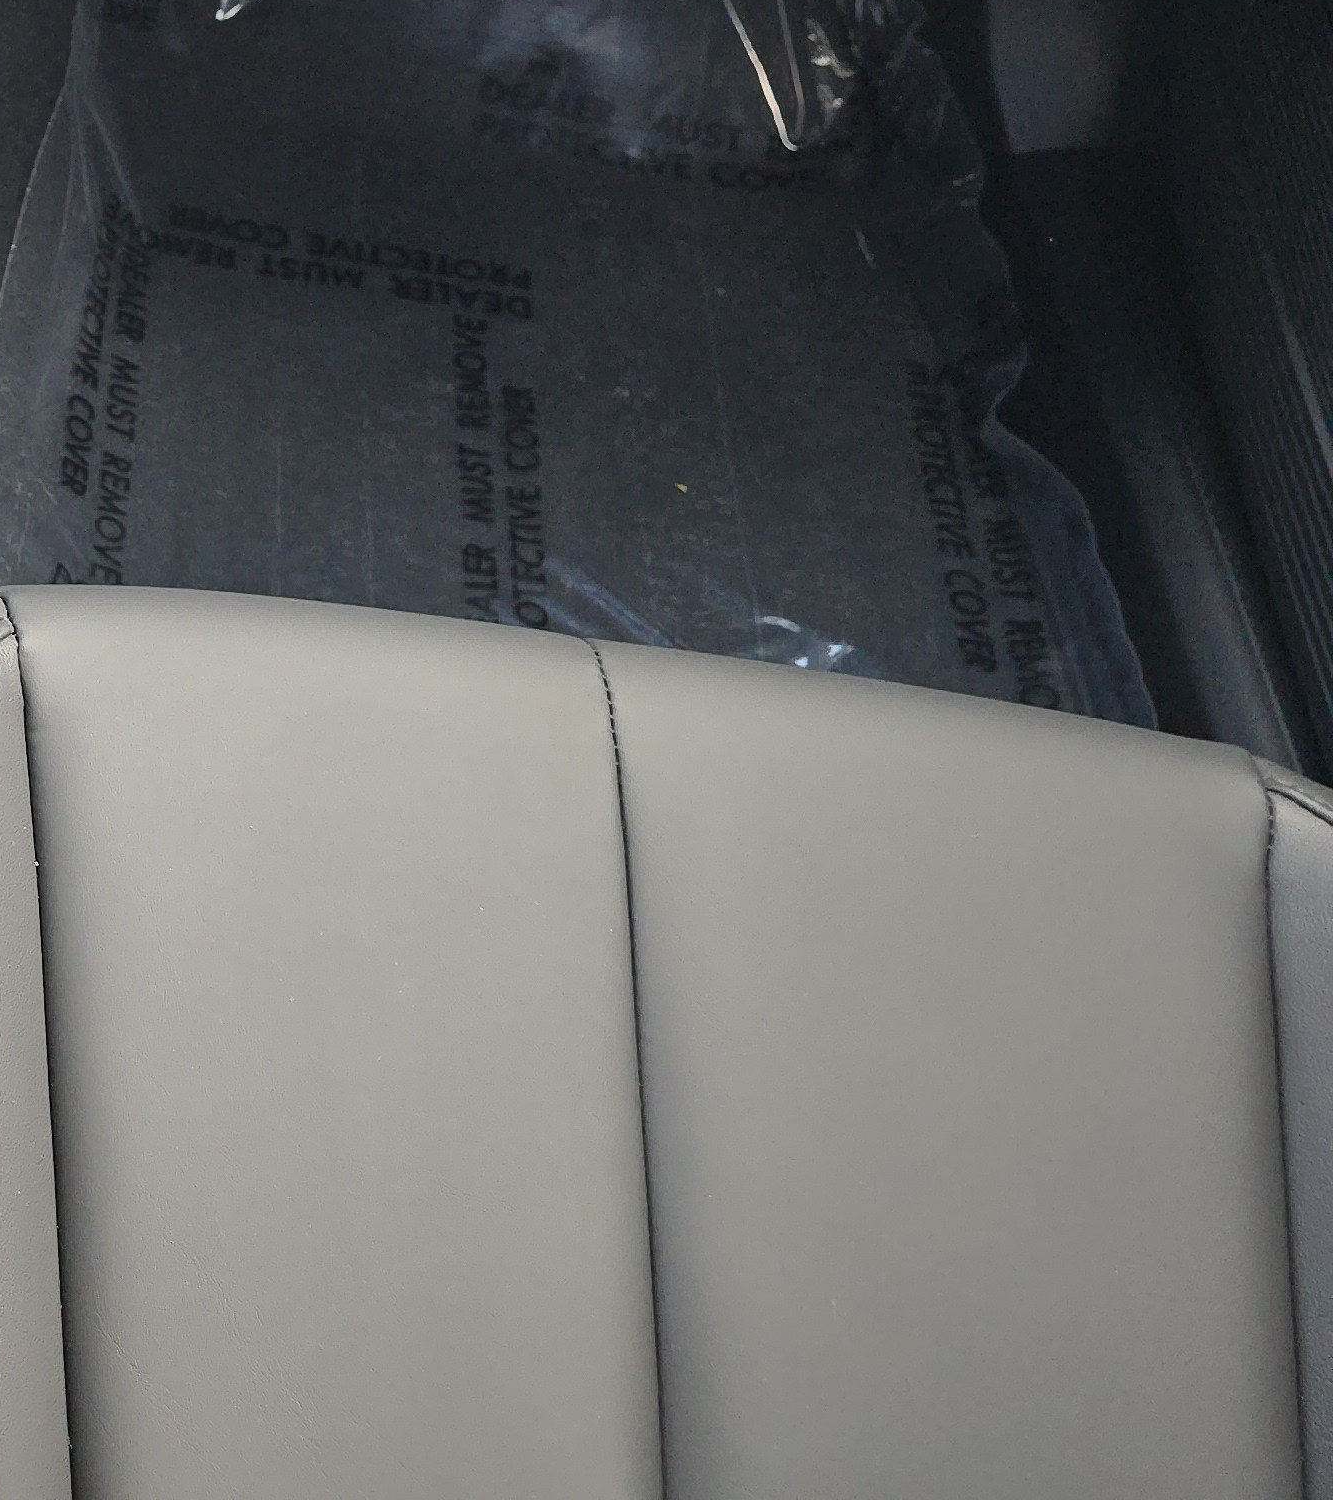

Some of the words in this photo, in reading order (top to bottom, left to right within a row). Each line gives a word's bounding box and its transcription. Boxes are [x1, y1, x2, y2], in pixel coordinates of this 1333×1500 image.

[255, 252, 367, 289] MUST
[106, 352, 141, 443] MUST
[452, 314, 494, 432] REMOVE
[59, 393, 96, 498] COVER
[456, 443, 495, 525] MUST
[87, 449, 133, 584] REMOVE
[461, 542, 501, 624] ALER
